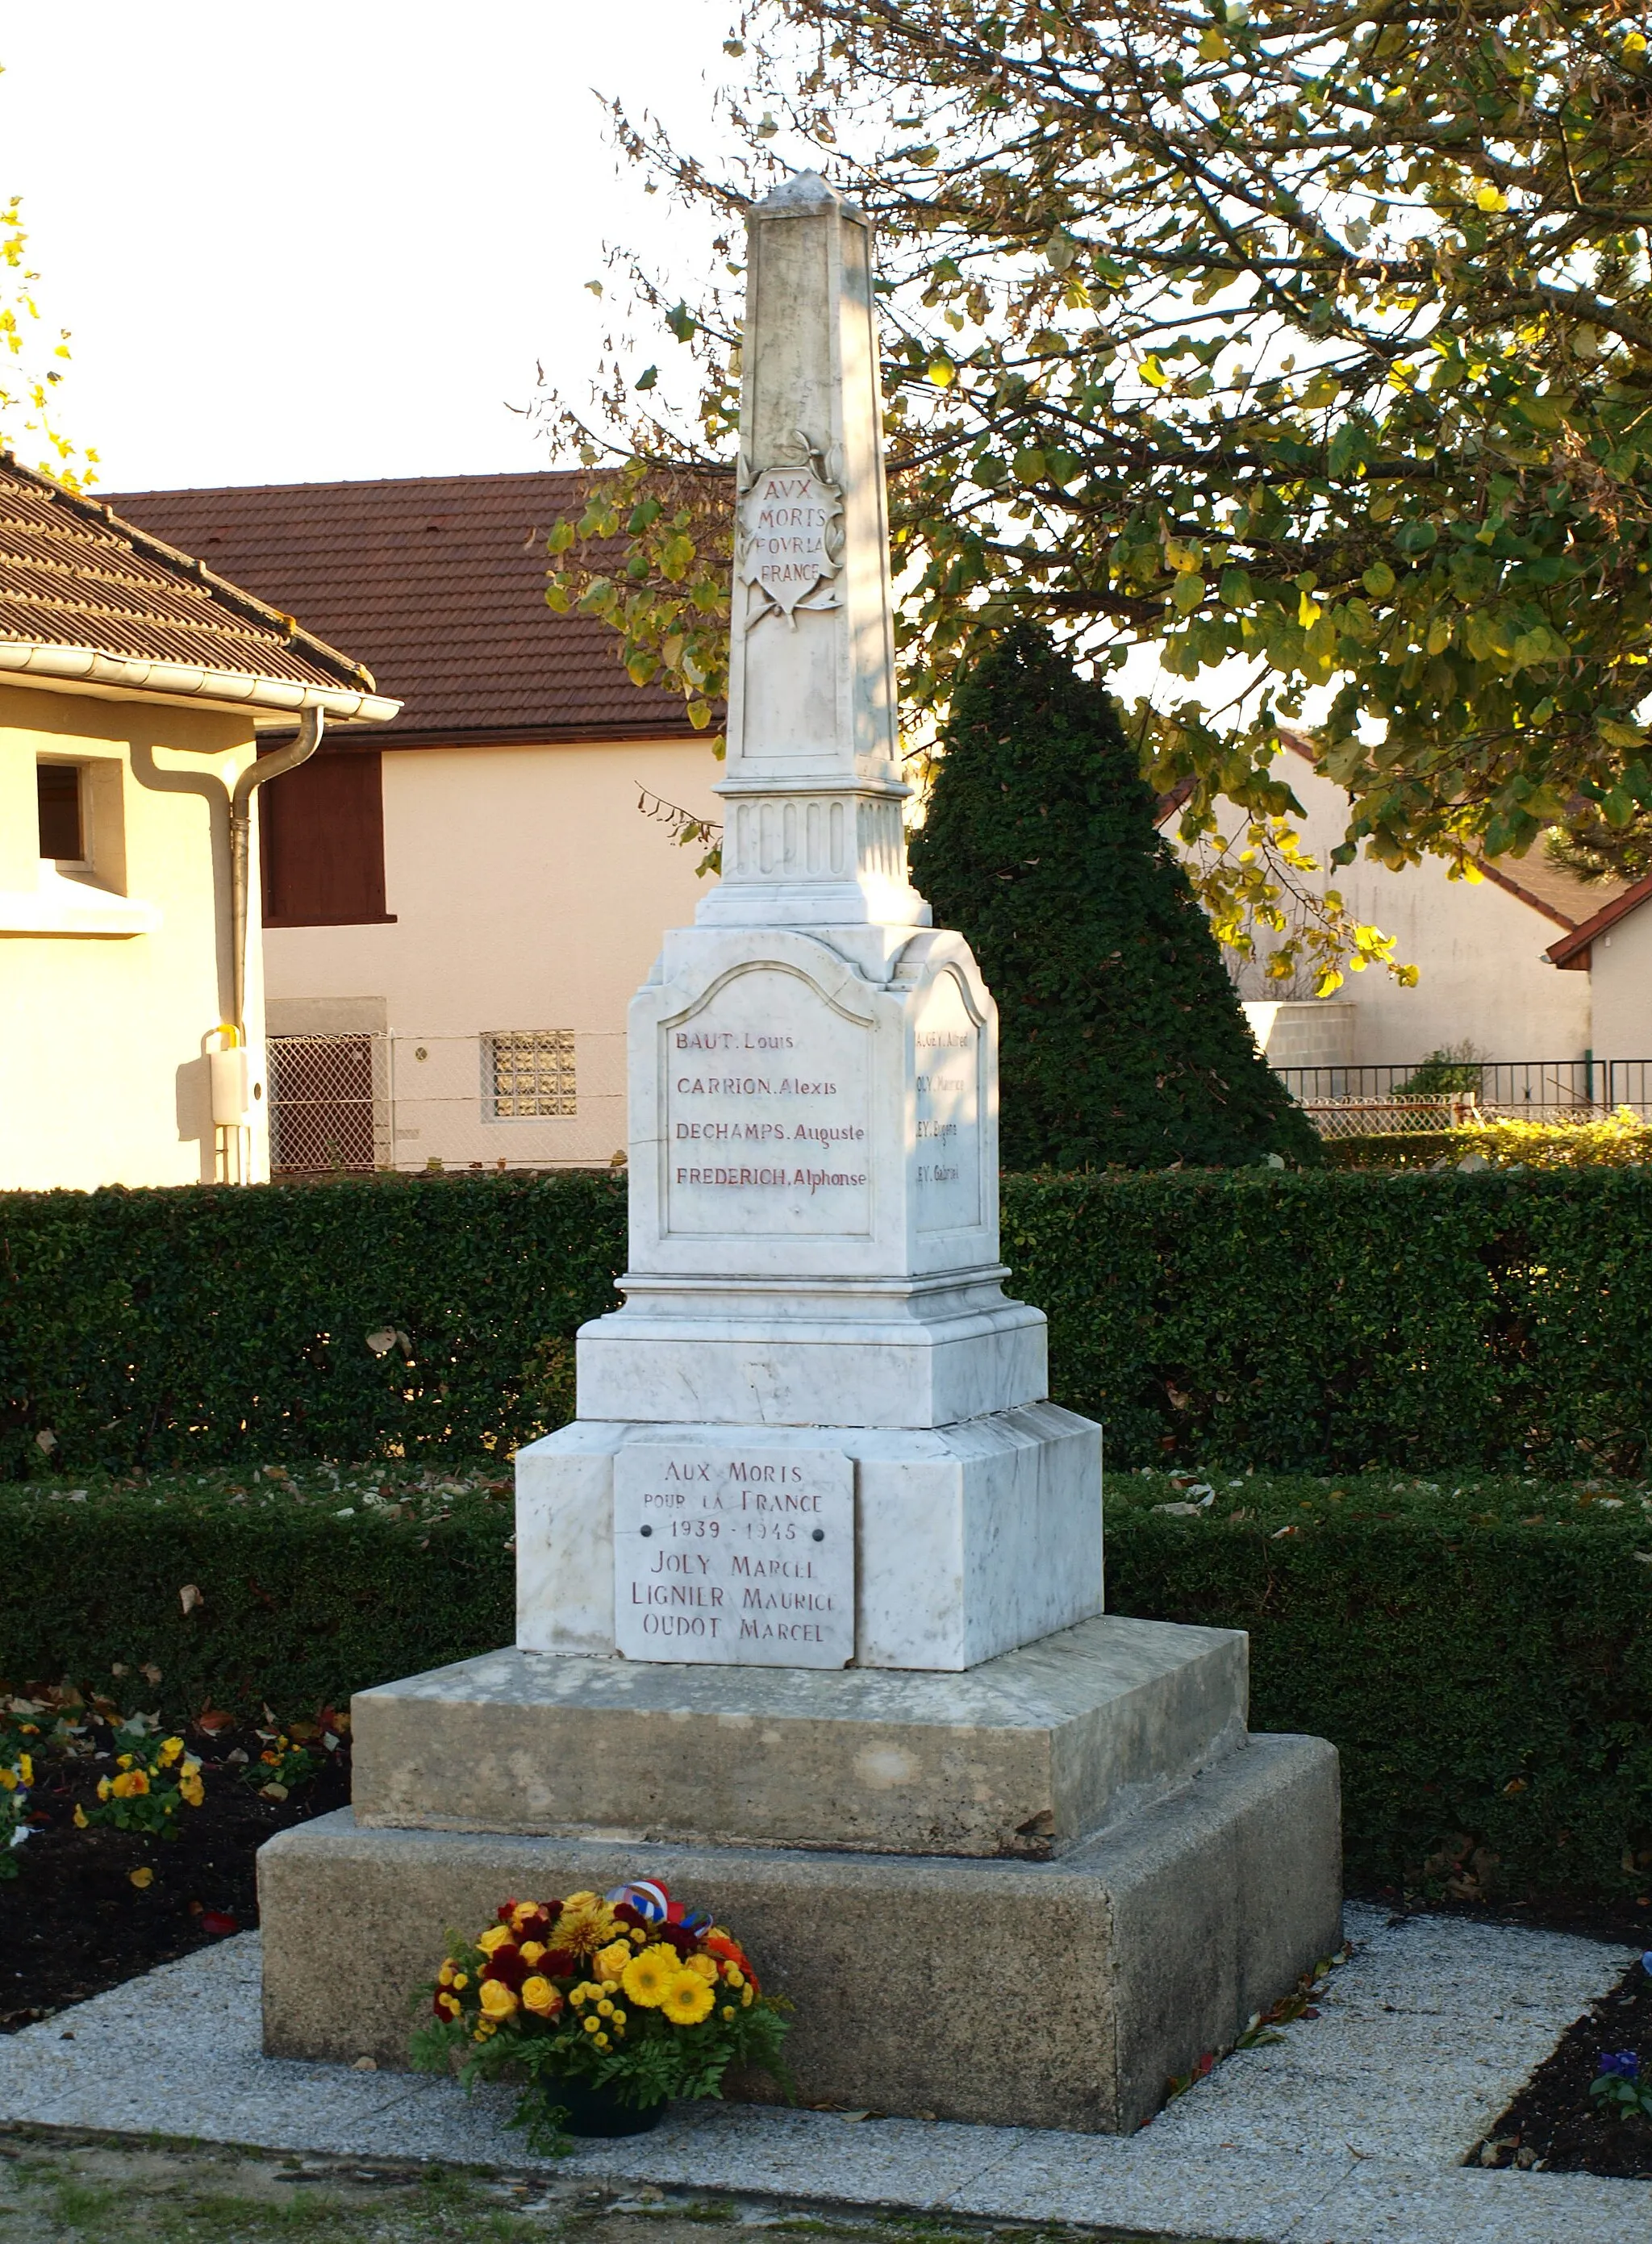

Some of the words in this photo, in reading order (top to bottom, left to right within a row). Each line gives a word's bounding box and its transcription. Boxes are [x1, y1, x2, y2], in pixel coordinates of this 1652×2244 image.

[764, 478, 813, 500] AVX
[758, 507, 826, 528] MORTS
[761, 563, 820, 582] FRANCE
[665, 1461, 710, 1482] AUX
[645, 1493, 685, 1509] POUR
[703, 1495, 724, 1510] LA
[741, 1491, 823, 1513] FRANCE
[672, 1520, 720, 1538] 1939
[747, 1523, 795, 1540] 1945
[651, 1550, 710, 1575] JOLY
[632, 1582, 724, 1607] LIGNIER
[644, 1613, 722, 1637] OUDOT
[740, 1619, 824, 1642] MARCEL
